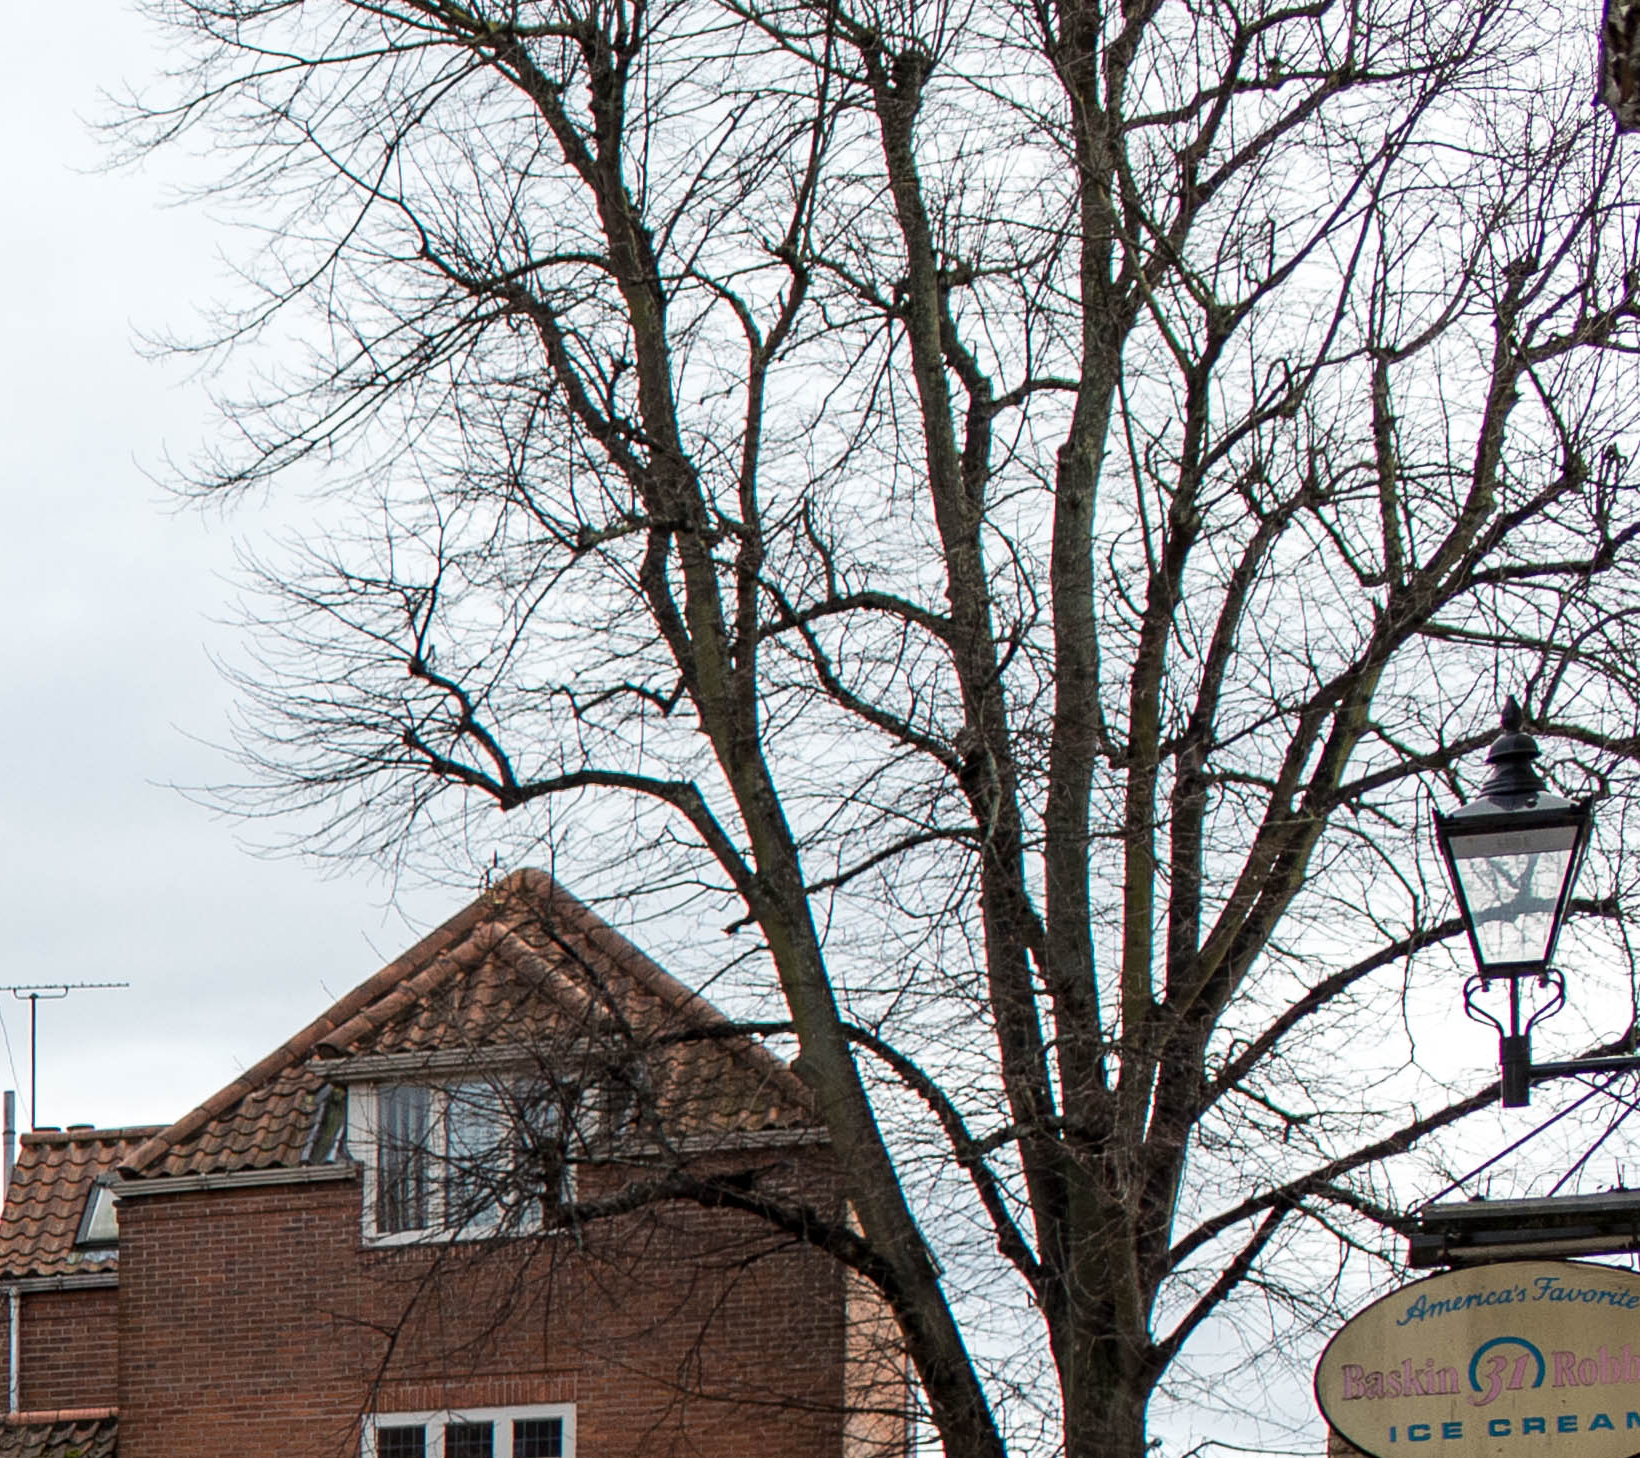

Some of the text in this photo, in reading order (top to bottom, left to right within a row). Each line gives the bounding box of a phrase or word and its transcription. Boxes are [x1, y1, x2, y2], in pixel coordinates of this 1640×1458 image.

[1397, 1277, 1639, 1326] America's Favorite
[1342, 1358, 1460, 1400] Baskin
[1468, 1354, 1528, 1406] 31
[1390, 1422, 1463, 1442] ICE
